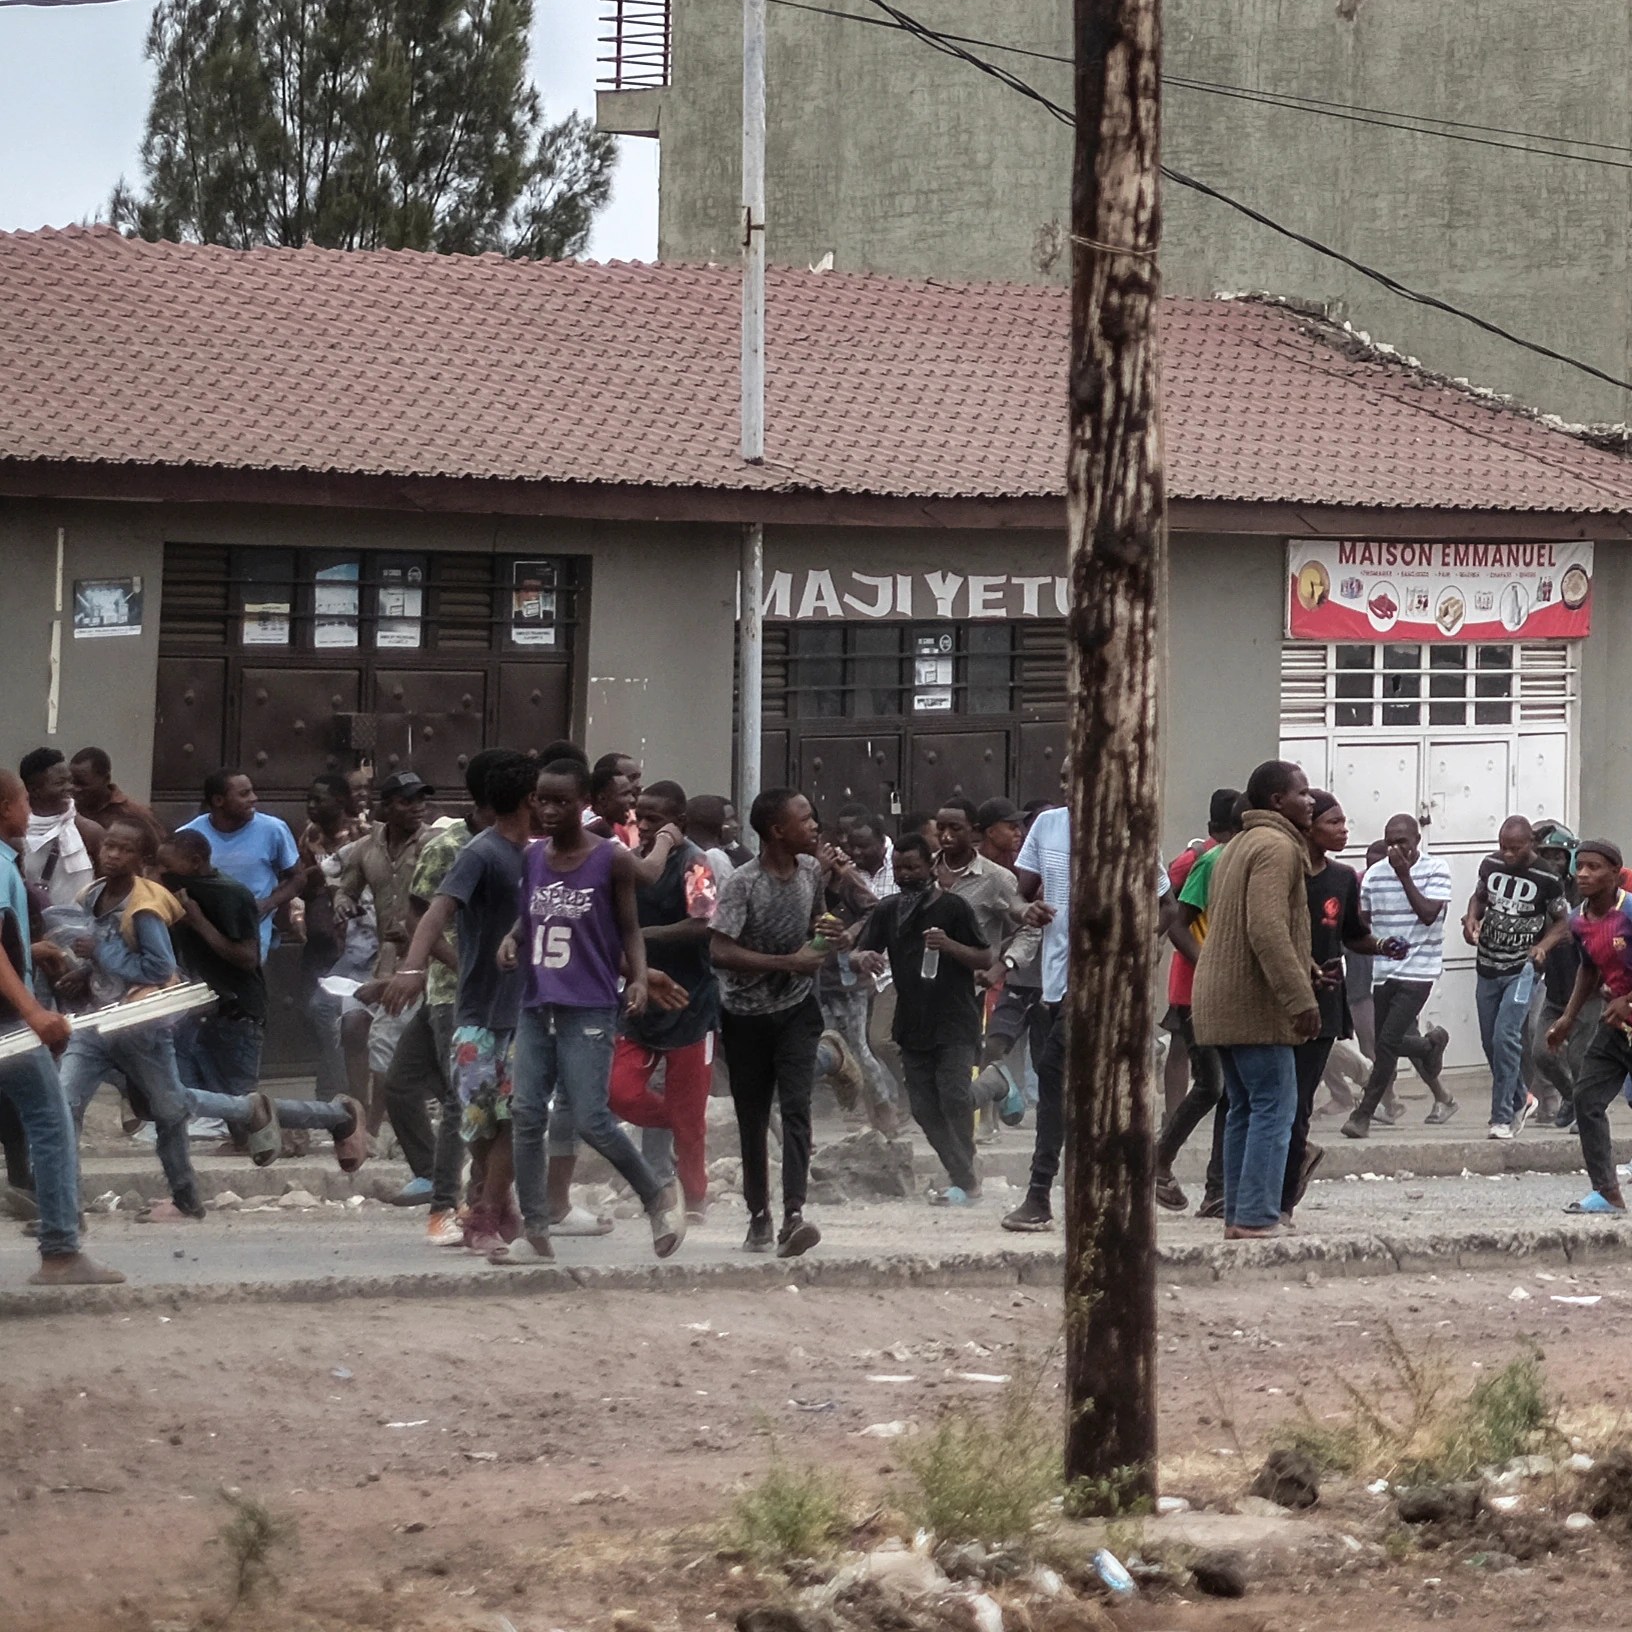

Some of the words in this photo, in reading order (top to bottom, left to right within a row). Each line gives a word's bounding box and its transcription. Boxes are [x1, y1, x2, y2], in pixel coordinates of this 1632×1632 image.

[1337, 541, 1433, 566] MAISON
[1440, 543, 1557, 568] EMMANUEL
[736, 569, 913, 619] MAJI
[532, 924, 572, 969] 15
